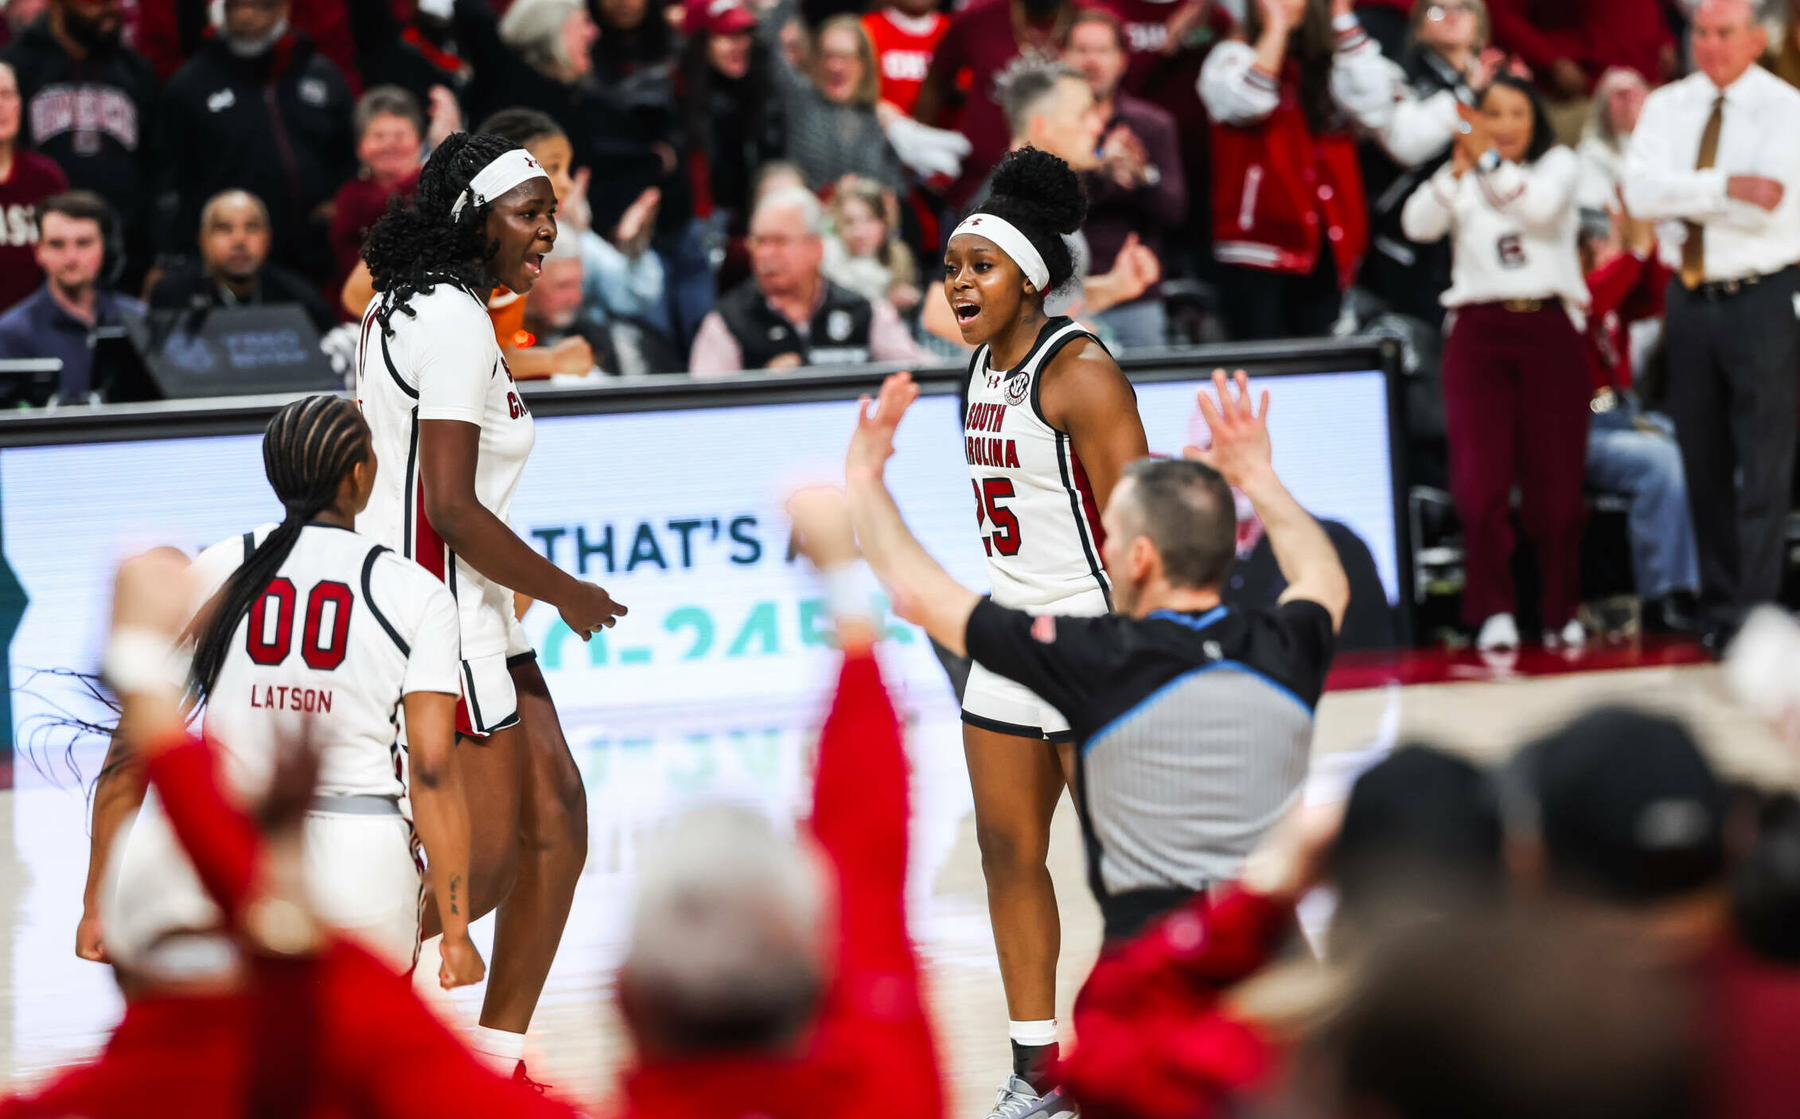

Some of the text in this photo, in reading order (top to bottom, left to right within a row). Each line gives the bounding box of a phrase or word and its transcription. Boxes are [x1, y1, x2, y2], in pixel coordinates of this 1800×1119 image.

[966, 402, 1008, 433] SOUTH
[964, 436, 1021, 468] ROLINA
[531, 515, 762, 575] THAT'S
[247, 577, 354, 671] 00
[251, 684, 333, 713] LATSON
